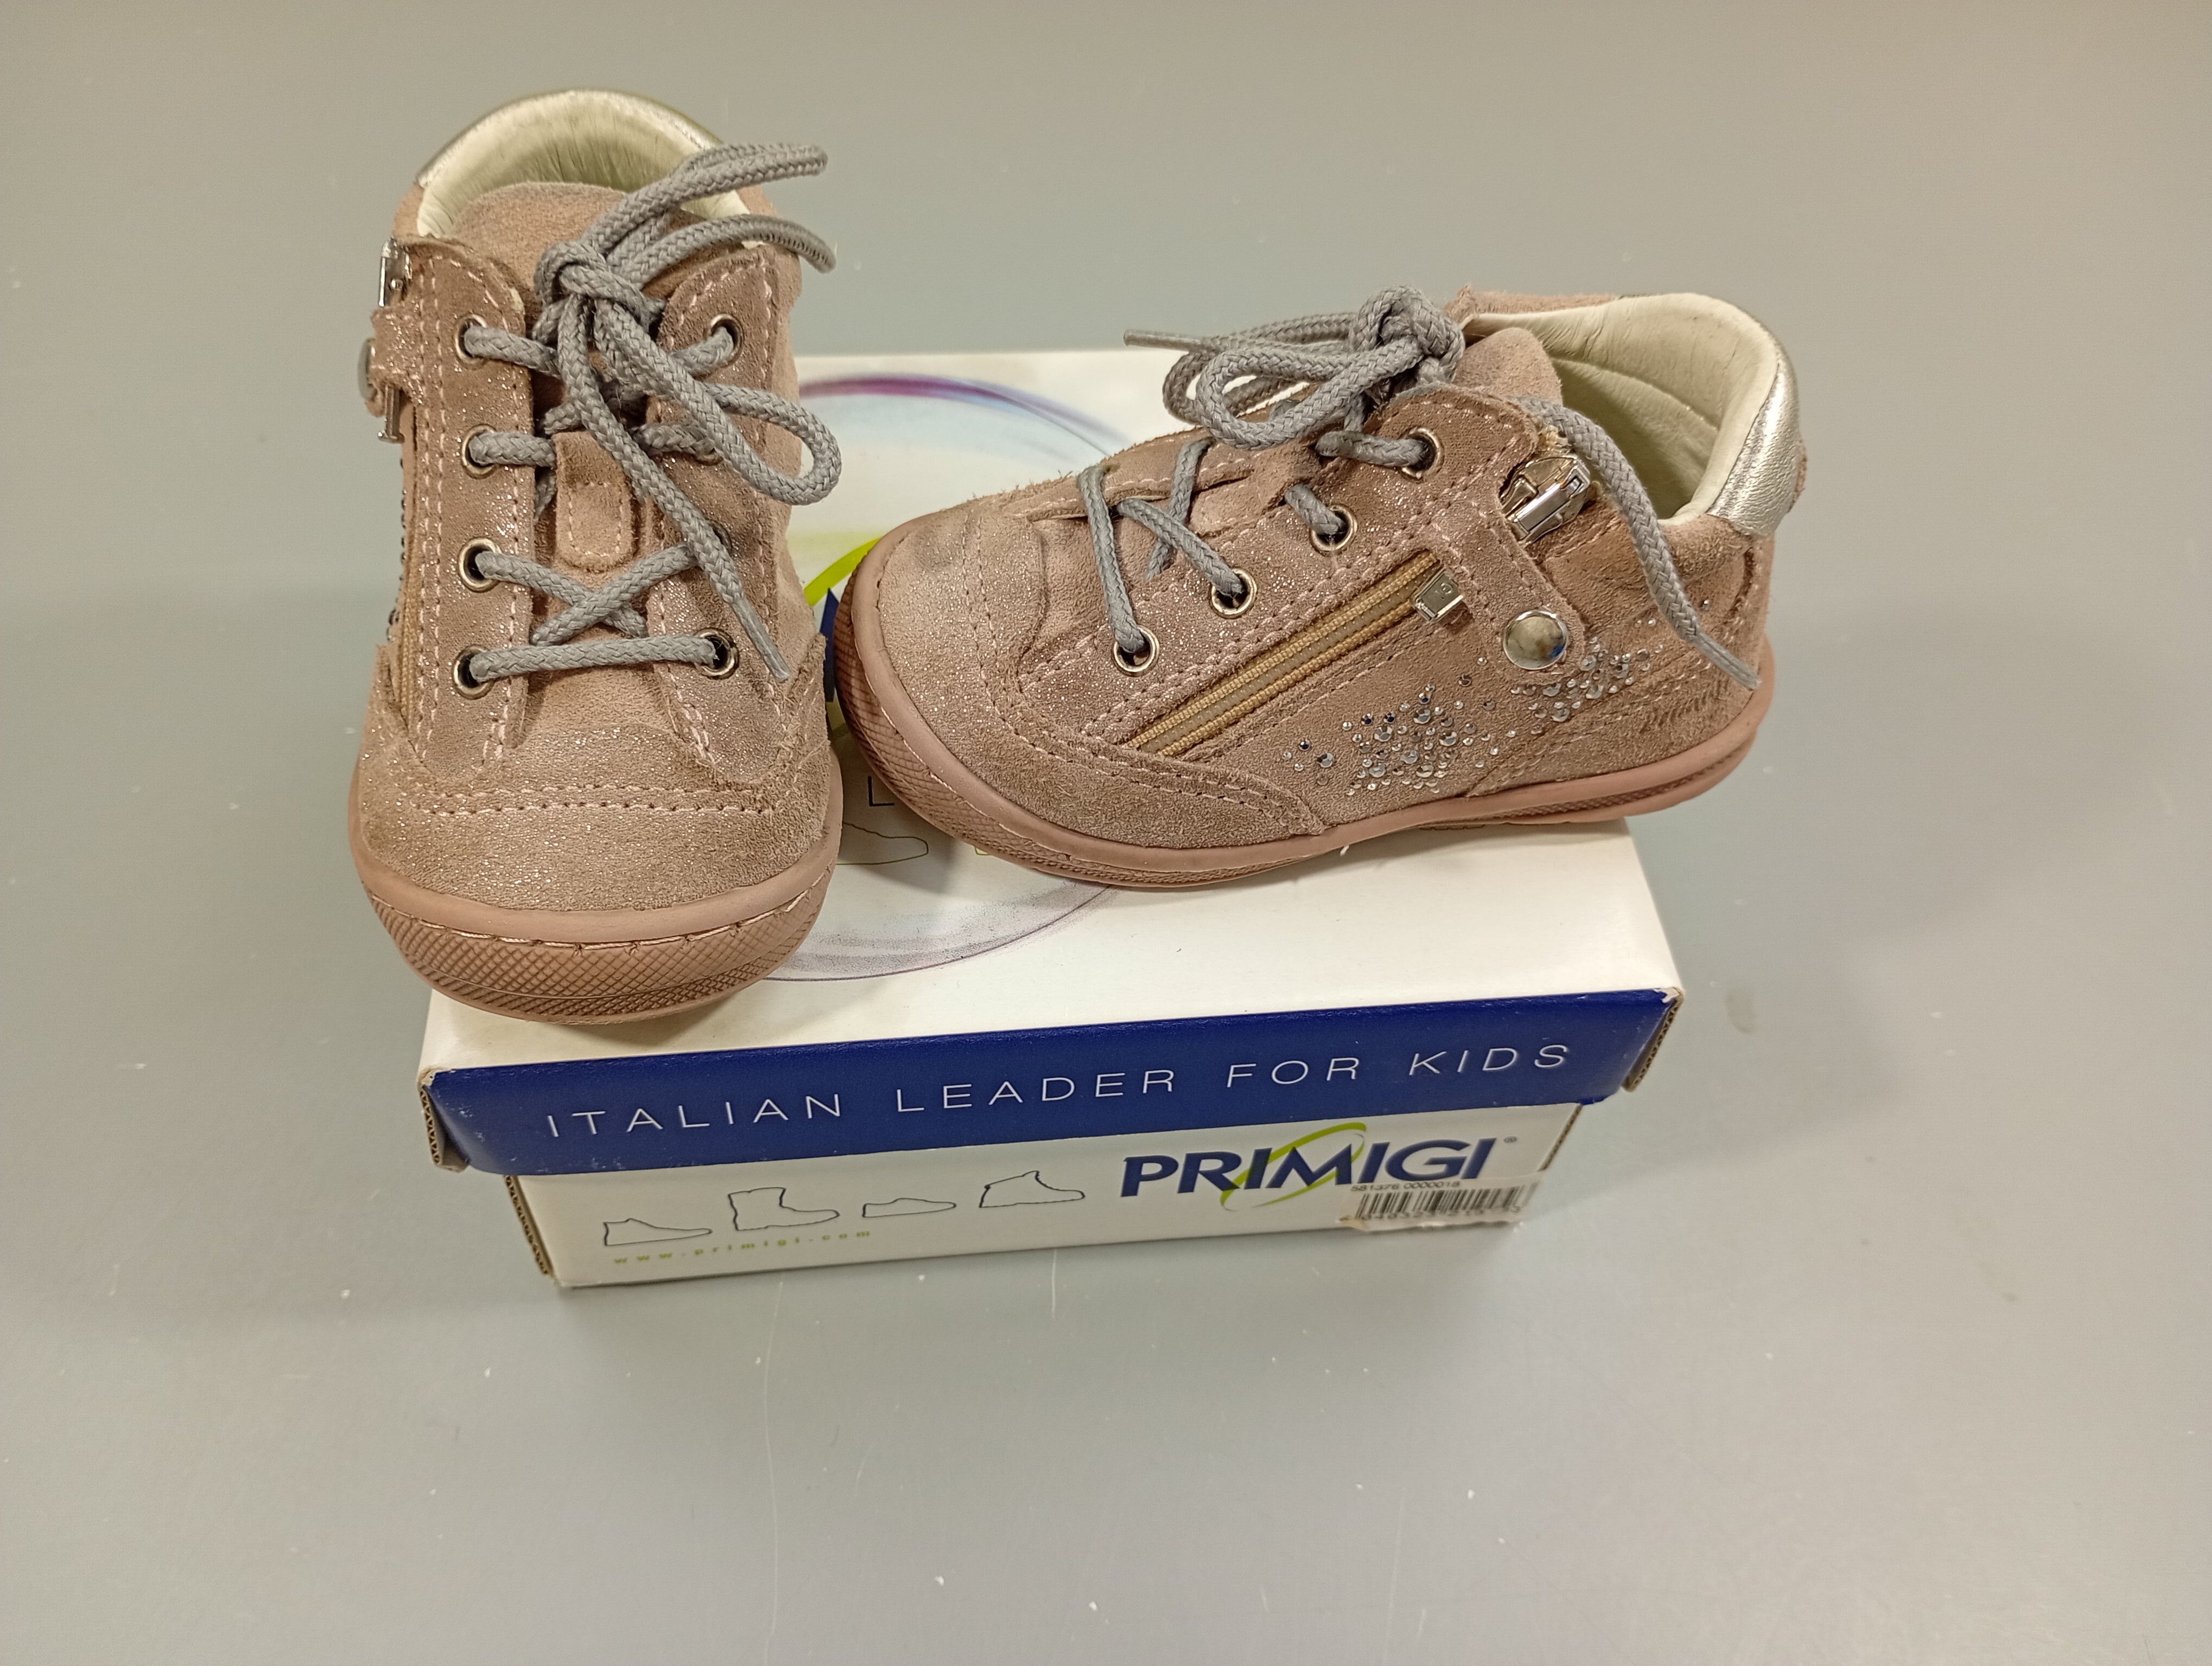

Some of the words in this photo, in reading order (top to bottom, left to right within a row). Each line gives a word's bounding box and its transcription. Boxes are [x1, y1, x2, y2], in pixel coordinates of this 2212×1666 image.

[547, 1093, 841, 1138] ITALIAN
[896, 1069, 1174, 1113] LEADER
[1226, 1057, 1360, 1088] FOR
[1408, 1044, 1569, 1076] KIDS
[1120, 1138, 1498, 1197] PRIMIGI
[614, 1231, 871, 1264] www.primigi.com
